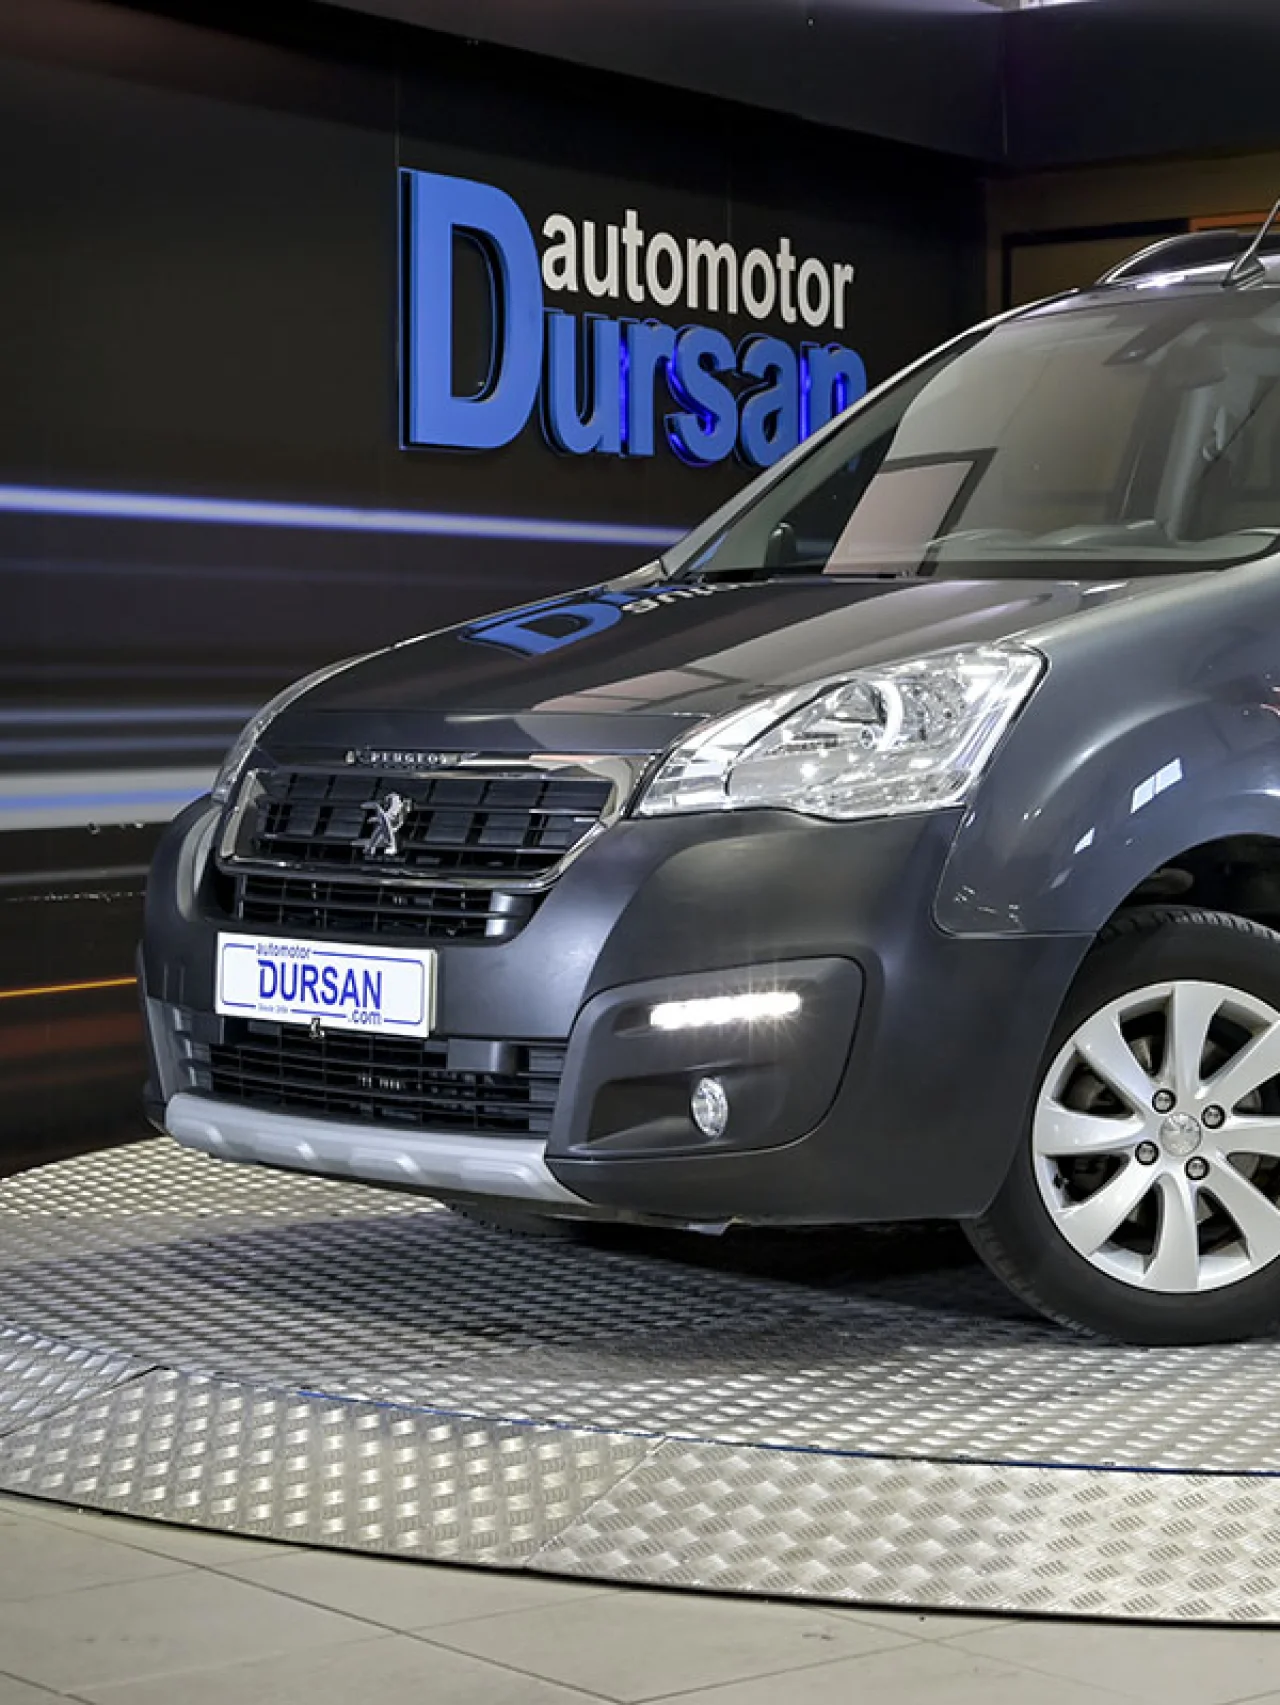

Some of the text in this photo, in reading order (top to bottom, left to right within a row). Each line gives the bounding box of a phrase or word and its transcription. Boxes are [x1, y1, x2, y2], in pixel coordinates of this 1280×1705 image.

[541, 209, 854, 329] automotor
[398, 166, 868, 467] Dursan
[256, 942, 311, 960] automotor
[257, 959, 382, 1010] DURSAN
[347, 1009, 382, 1025] .com
